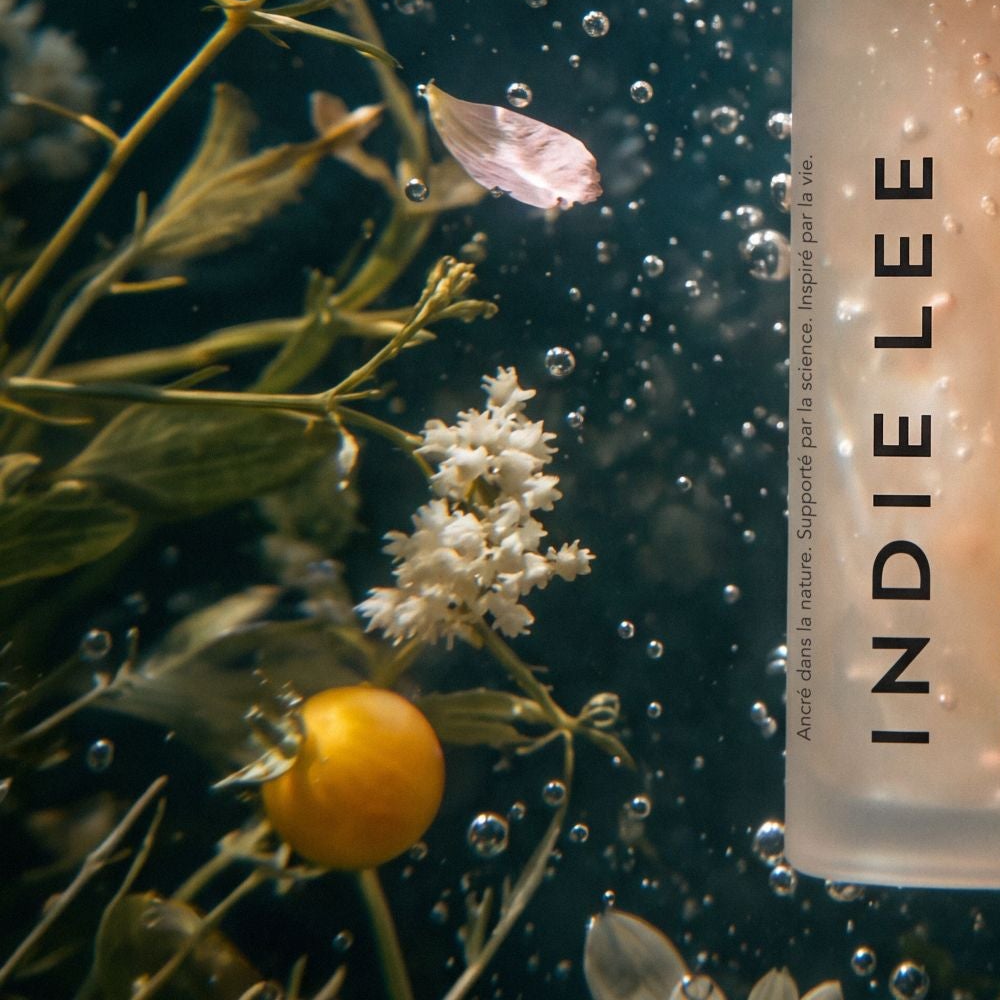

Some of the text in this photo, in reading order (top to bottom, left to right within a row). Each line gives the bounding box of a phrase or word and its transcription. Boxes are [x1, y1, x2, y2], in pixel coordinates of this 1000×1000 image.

[795, 155, 818, 741] Ancré dans la nature. Supporté par la science. Inspiré par la vie.
[871, 156, 932, 744] INDIE LEE
